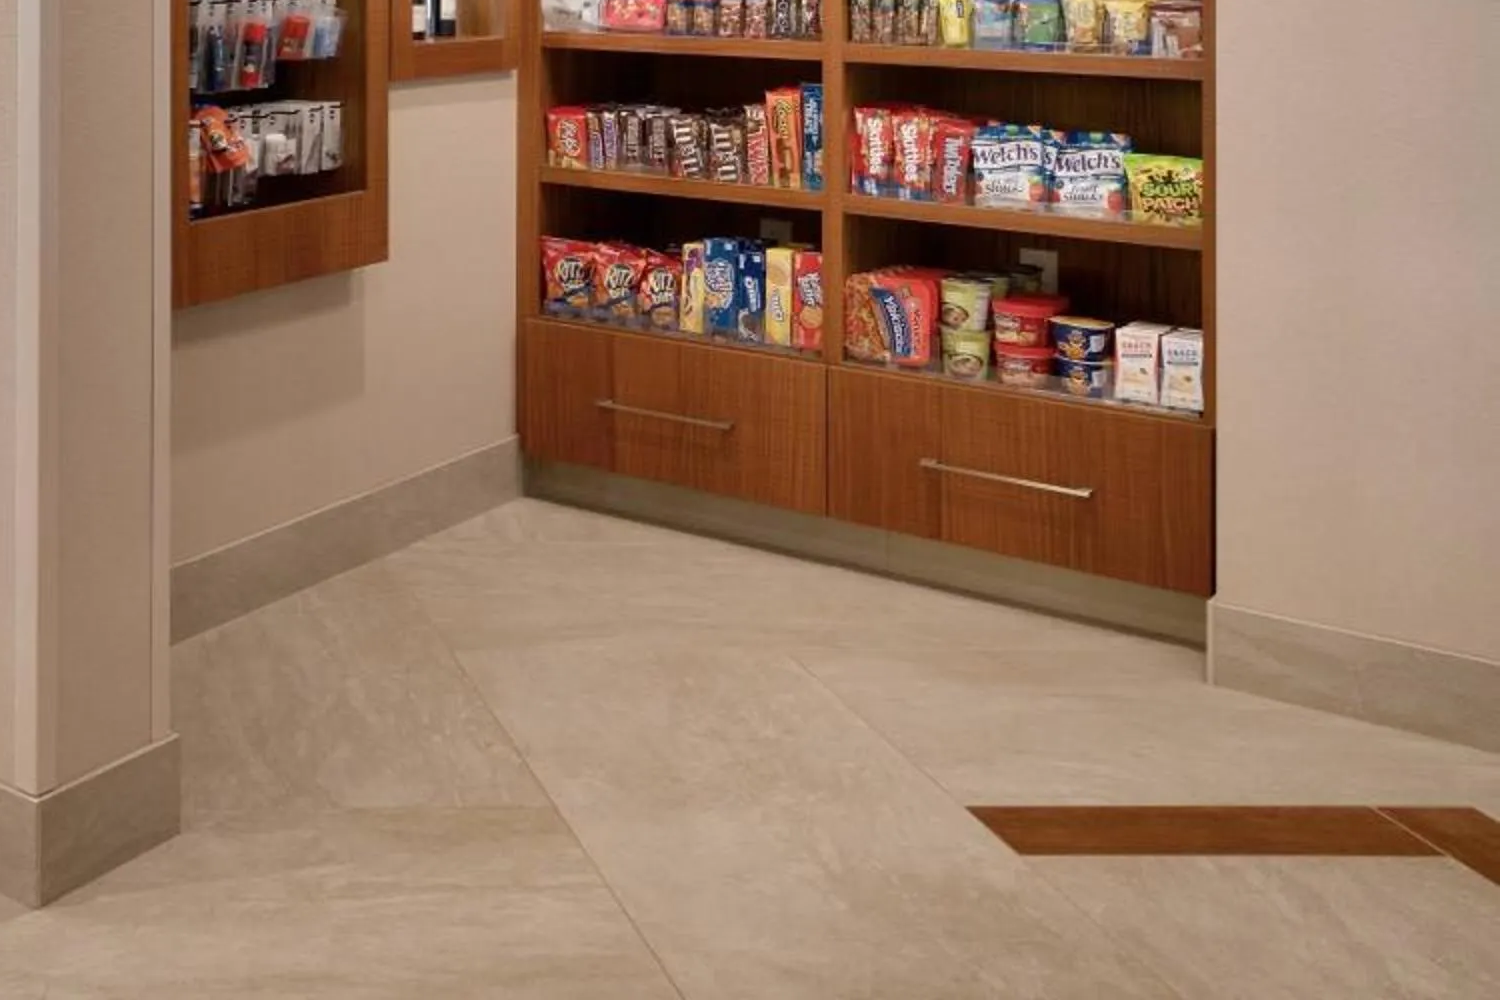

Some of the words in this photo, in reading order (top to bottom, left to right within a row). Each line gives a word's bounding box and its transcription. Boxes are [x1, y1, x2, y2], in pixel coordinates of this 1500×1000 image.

[867, 117, 884, 175] Skittles
[899, 120, 919, 182] Skittles
[973, 143, 1039, 164] Welch's
[1053, 151, 1121, 174] Welch's
[1142, 181, 1197, 198] SOUR
[1142, 196, 1198, 211] PATCH
